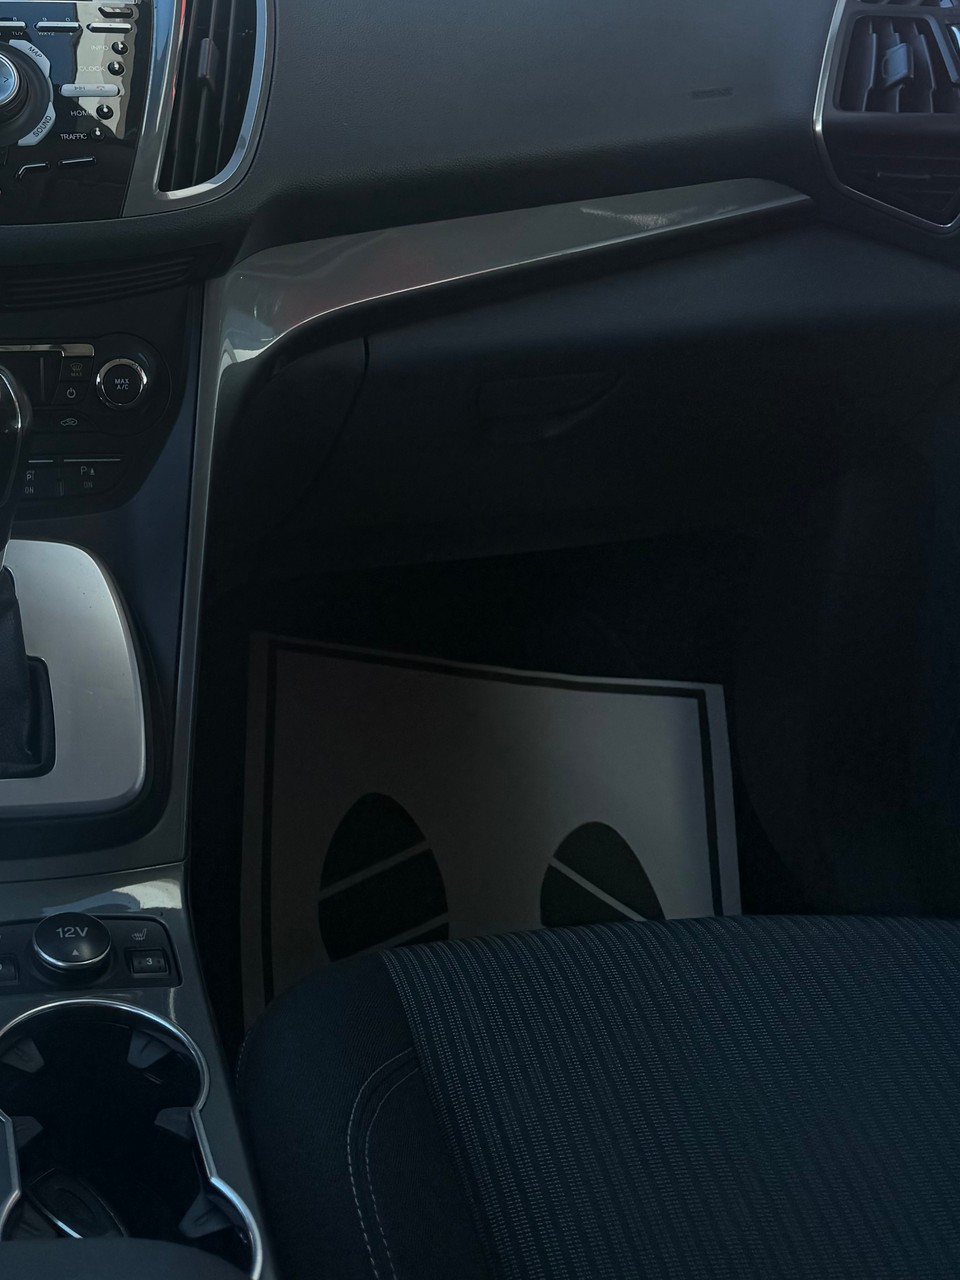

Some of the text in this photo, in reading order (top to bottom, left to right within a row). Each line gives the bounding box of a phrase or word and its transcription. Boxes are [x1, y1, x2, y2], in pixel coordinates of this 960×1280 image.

[27, 46, 43, 59] MAP
[32, 115, 52, 138] SOUND
[56, 926, 89, 939] 12V
[146, 957, 153, 965] 3
